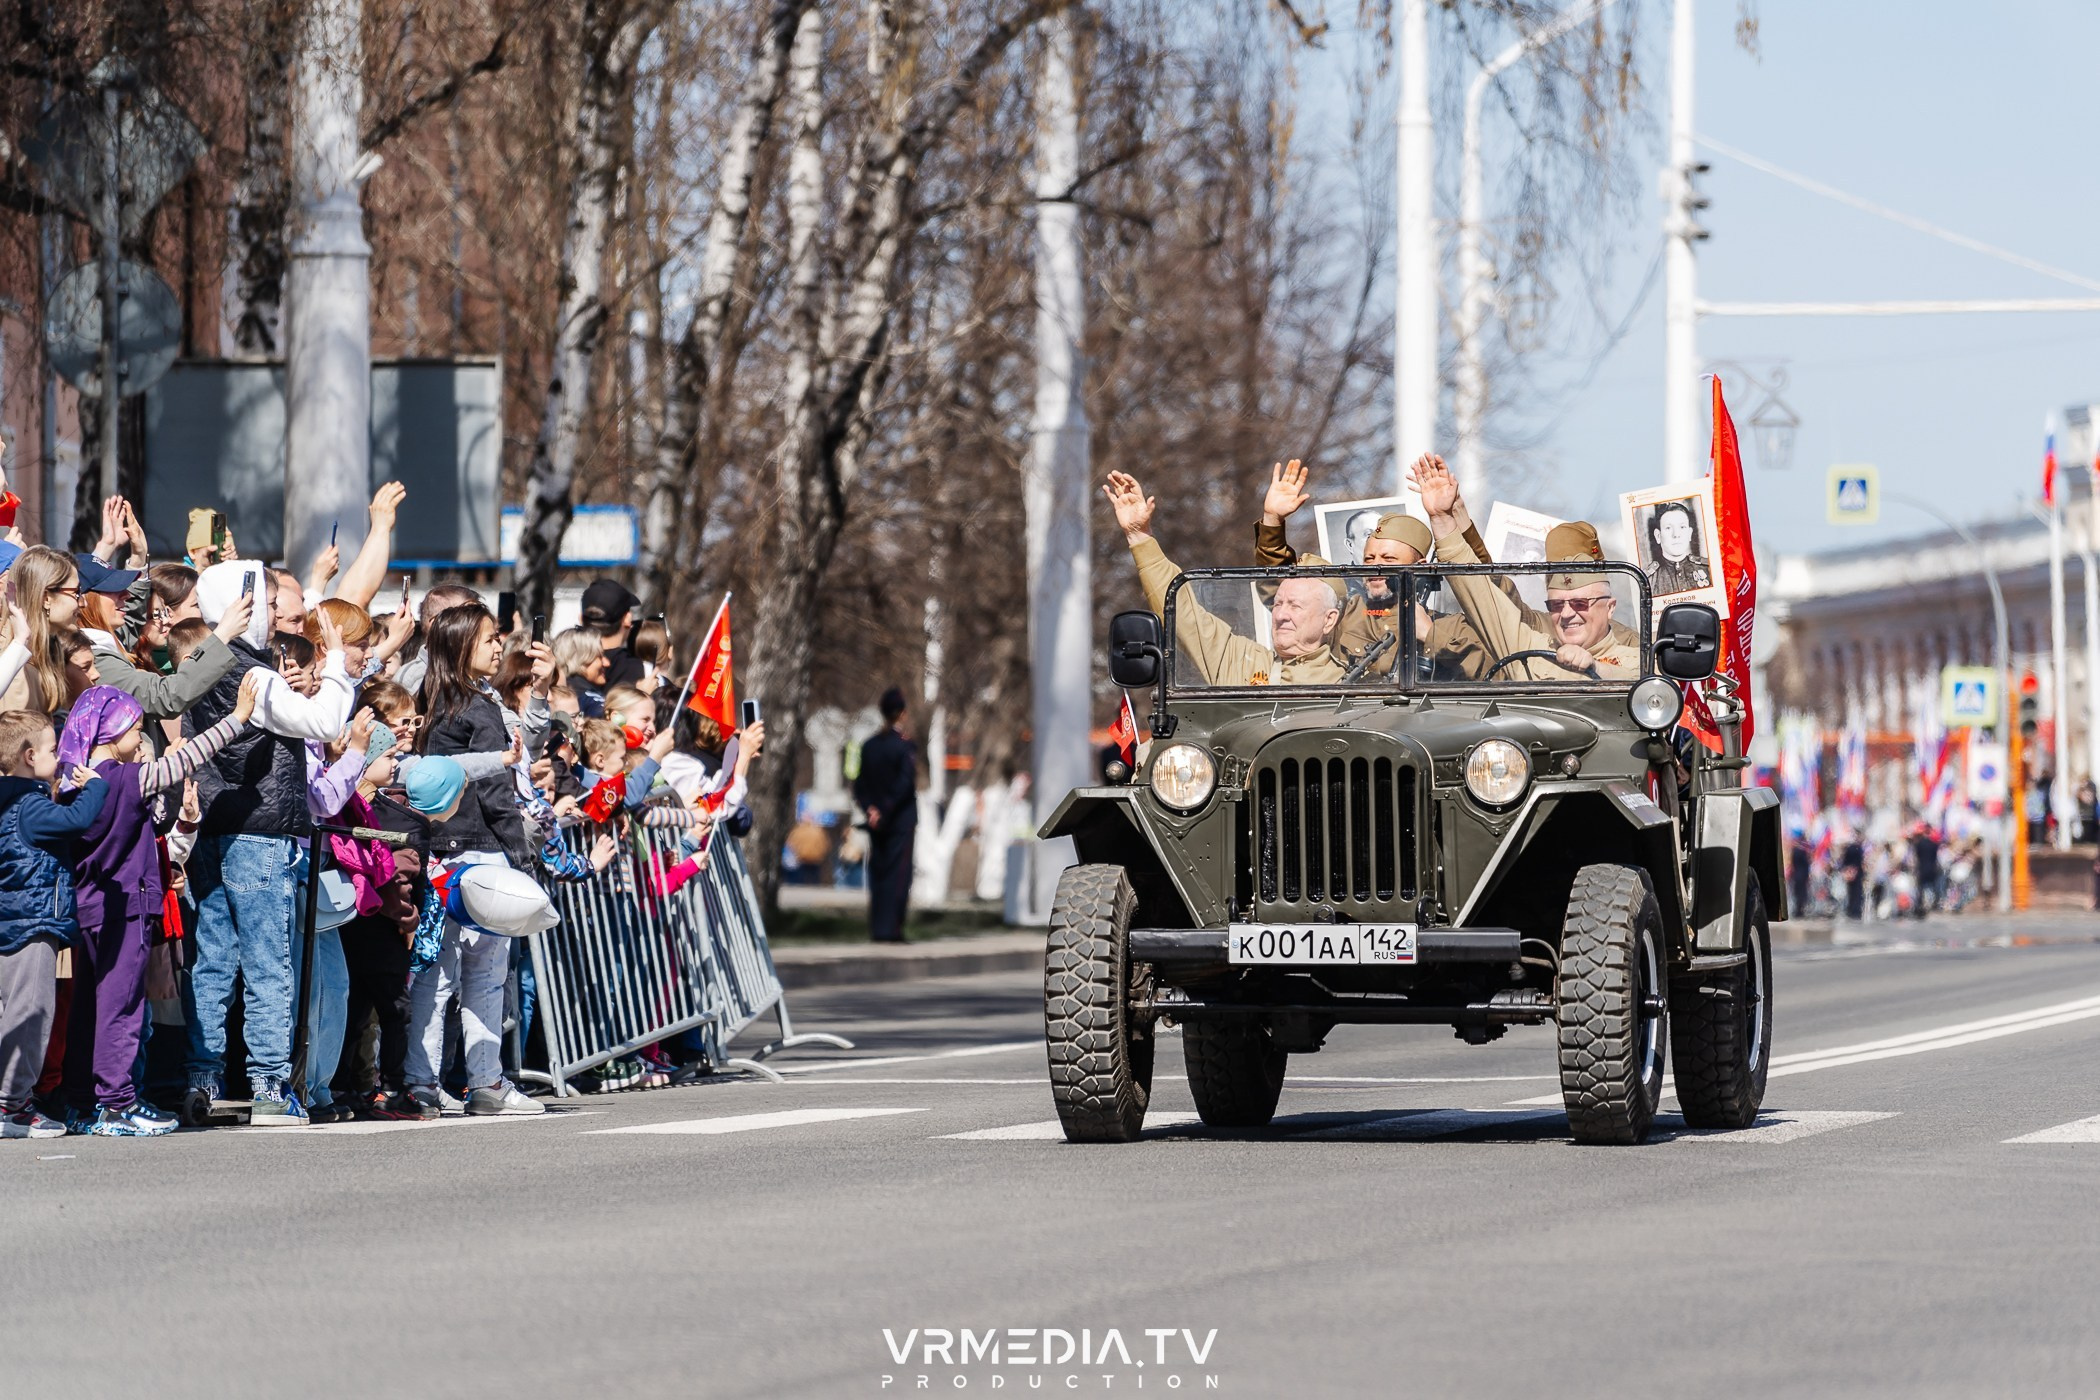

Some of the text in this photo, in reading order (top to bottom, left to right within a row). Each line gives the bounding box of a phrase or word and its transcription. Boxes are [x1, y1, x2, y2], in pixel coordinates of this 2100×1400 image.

[1239, 928, 1407, 959] К001АА 142
[1374, 952, 1396, 960] RUS
